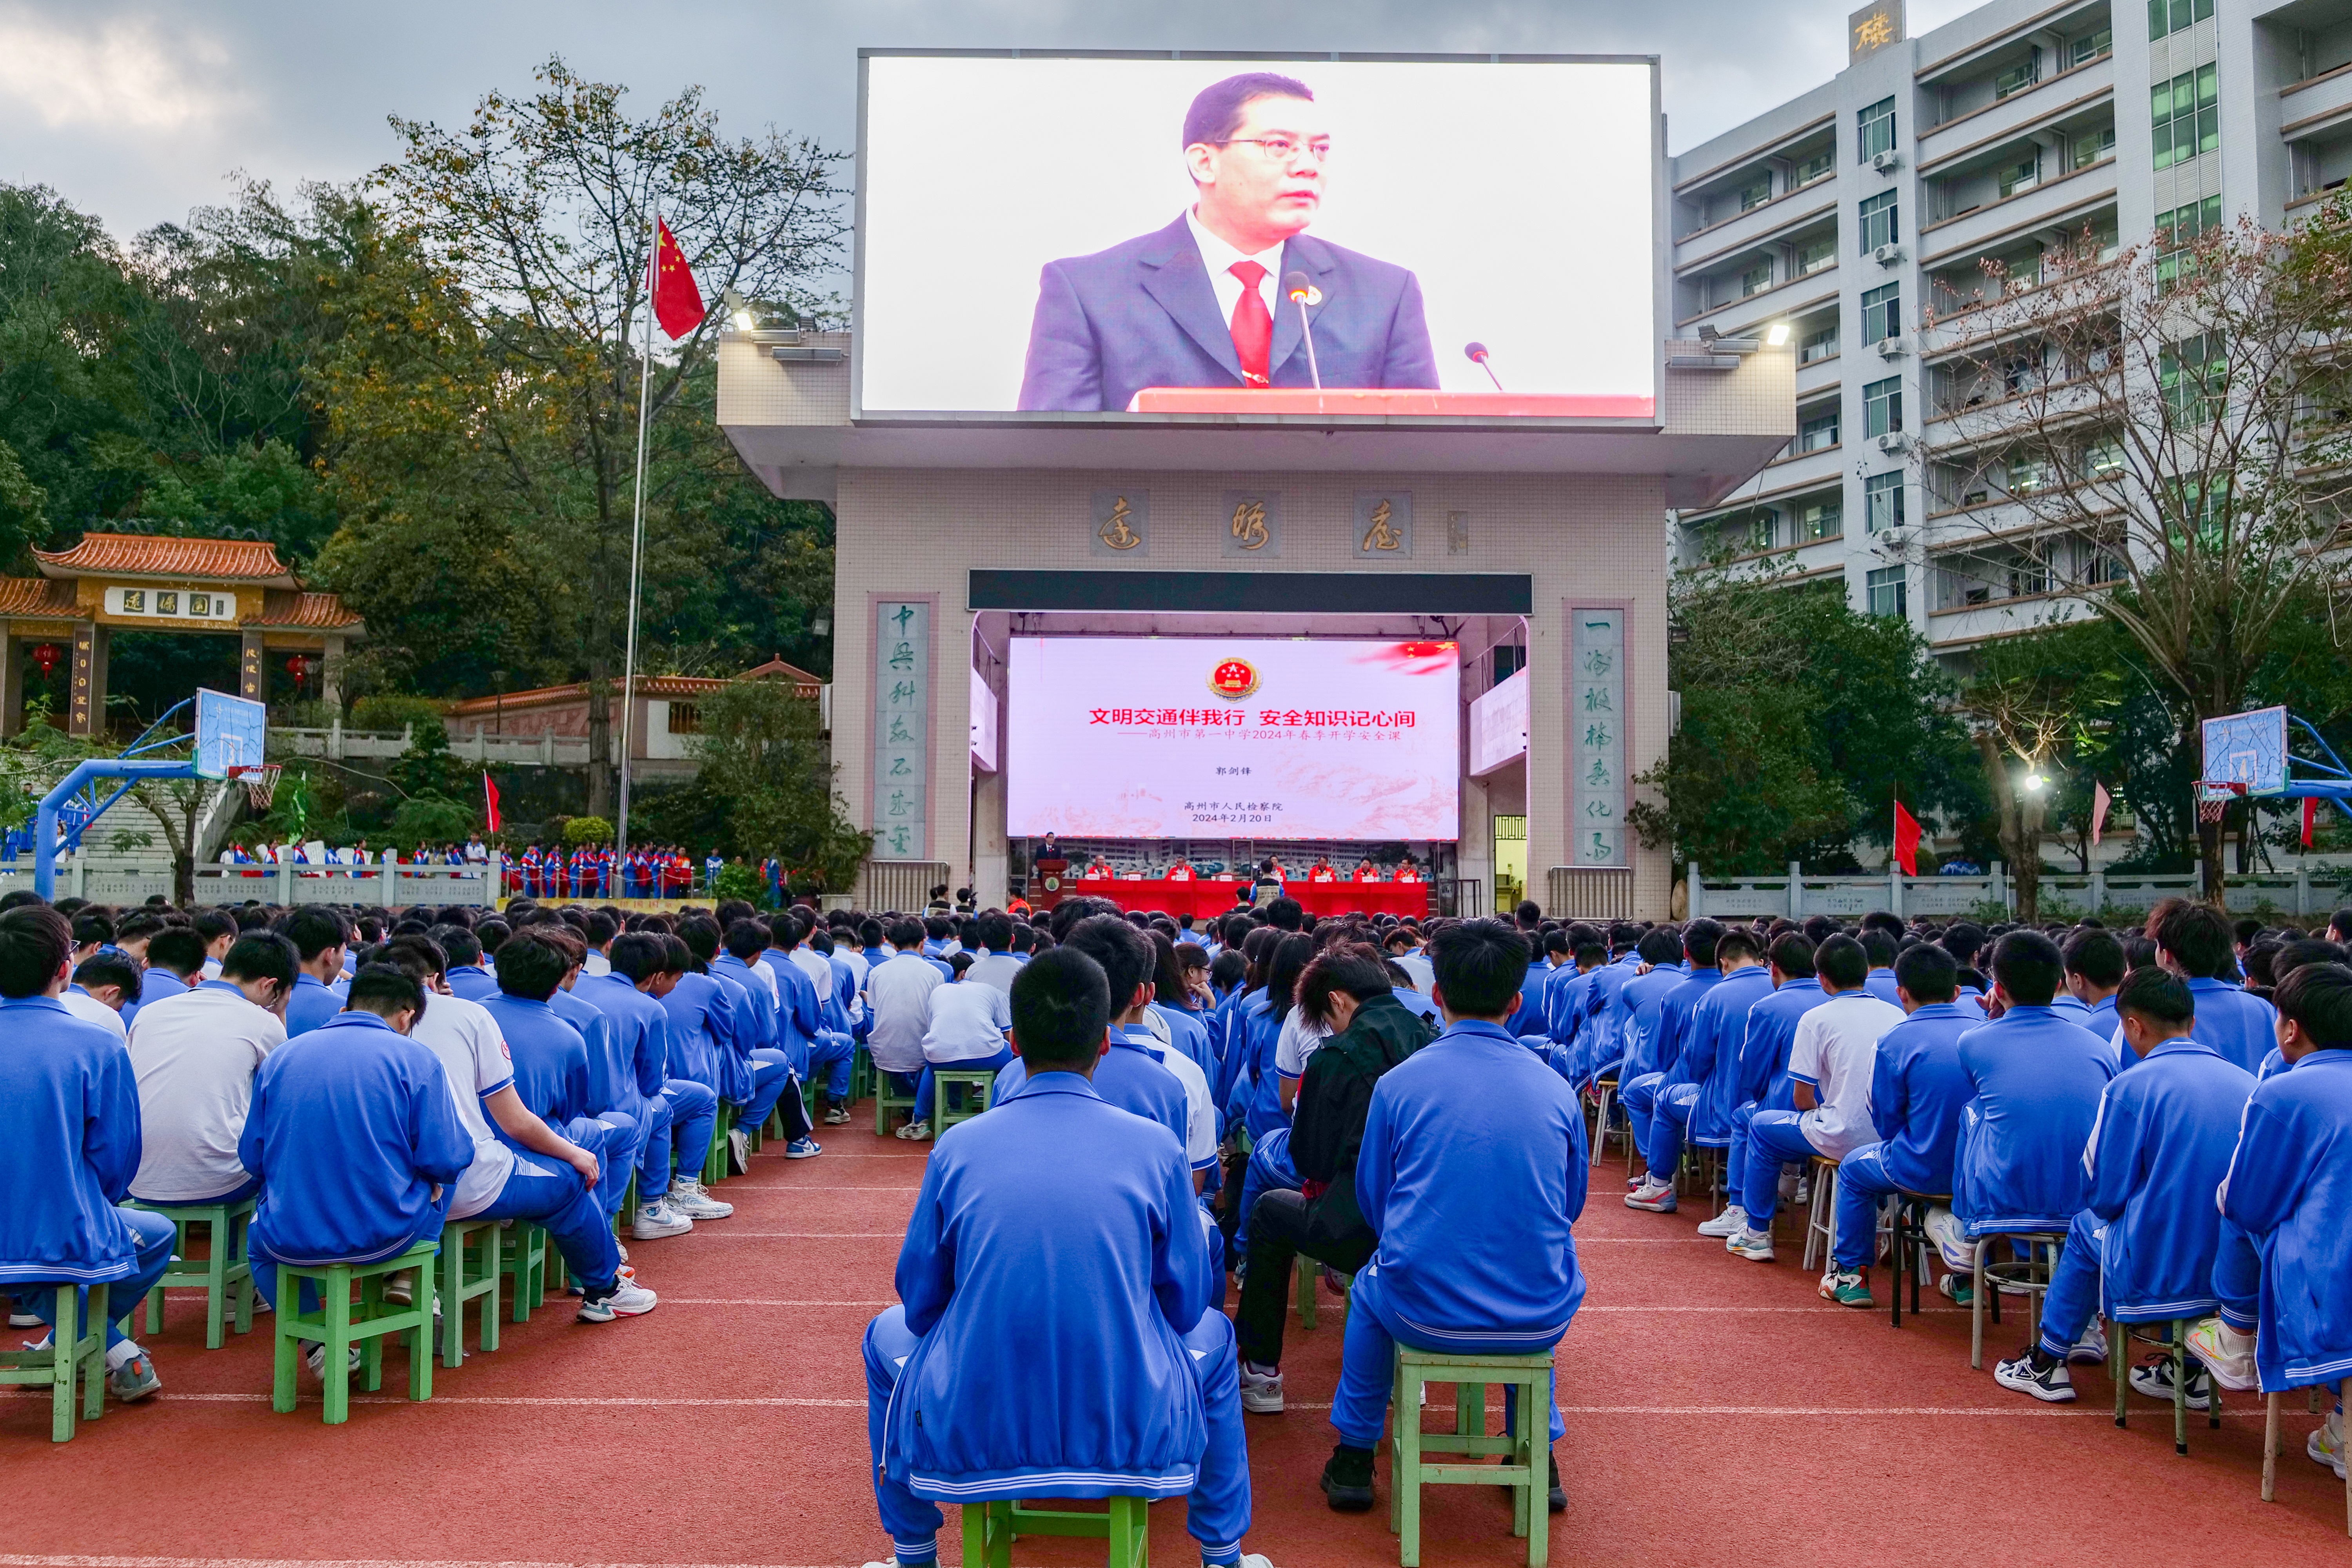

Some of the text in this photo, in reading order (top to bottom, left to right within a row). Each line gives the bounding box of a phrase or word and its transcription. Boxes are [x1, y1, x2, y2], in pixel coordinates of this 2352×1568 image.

[1089, 708, 1415, 727] 文明交通伴我行 安全知识记心间
[1216, 766, 1251, 776] 郭剑锋
[1184, 801, 1283, 811] 高州市人民检察院
[1192, 814, 1271, 823] 2024年2月20日
